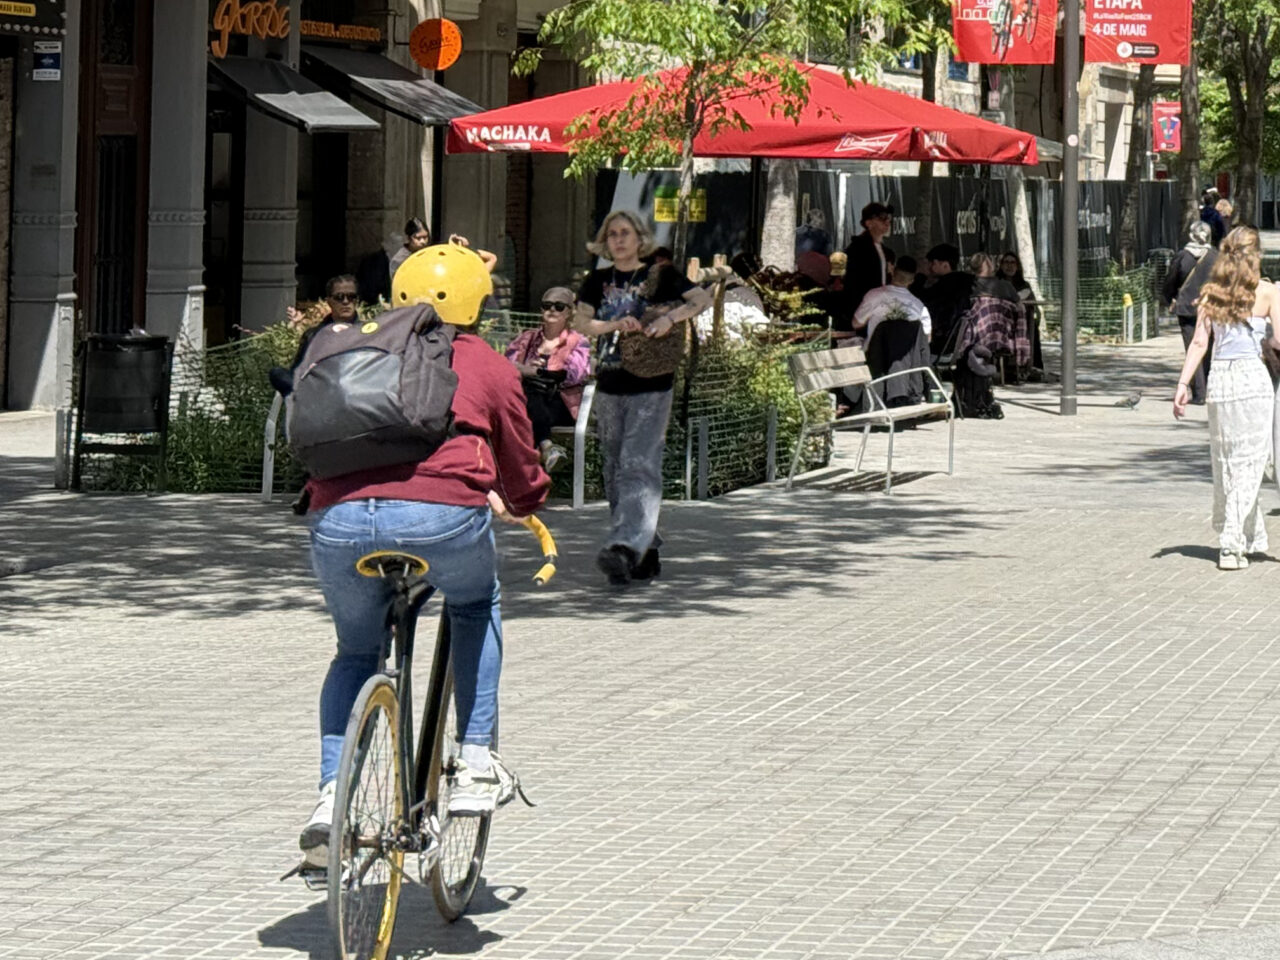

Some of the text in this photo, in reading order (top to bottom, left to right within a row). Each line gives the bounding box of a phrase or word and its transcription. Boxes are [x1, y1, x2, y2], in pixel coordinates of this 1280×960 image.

[1092, 23, 1147, 37] 4 DE MAIG
[466, 125, 552, 144] MACHAKA
